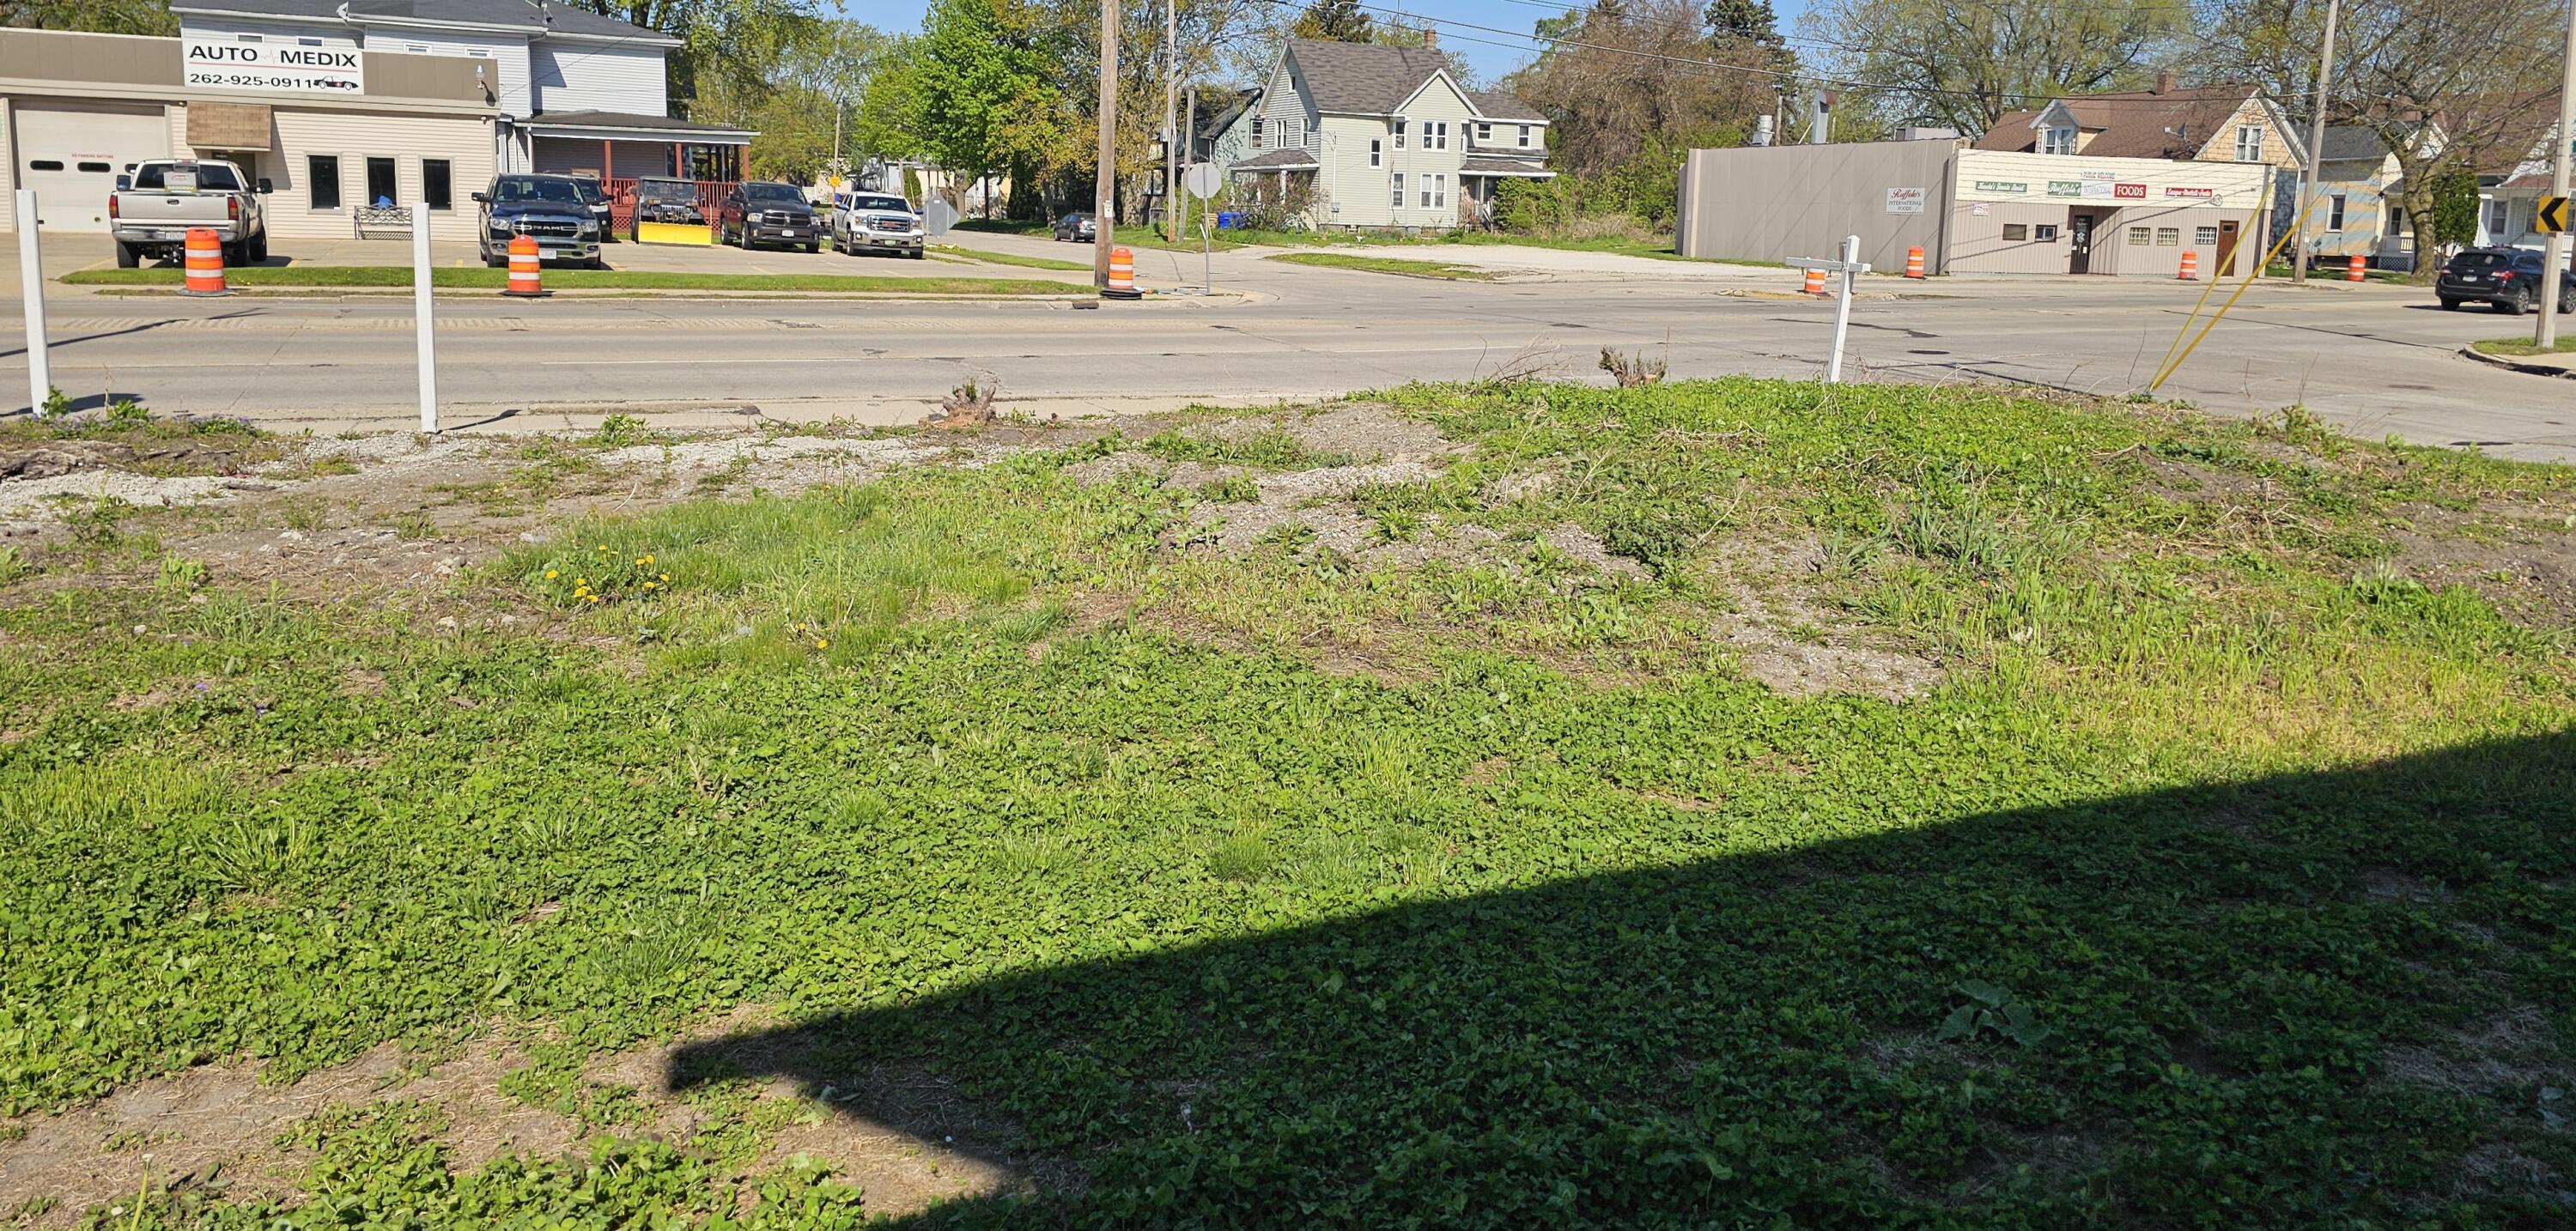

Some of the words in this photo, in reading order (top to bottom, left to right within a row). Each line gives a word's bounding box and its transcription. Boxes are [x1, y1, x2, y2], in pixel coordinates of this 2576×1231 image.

[189, 45, 258, 62] AUTO
[280, 50, 357, 67] MEDIX
[190, 73, 312, 88] 262-925-0911
[2117, 185, 2144, 196] FOODS
